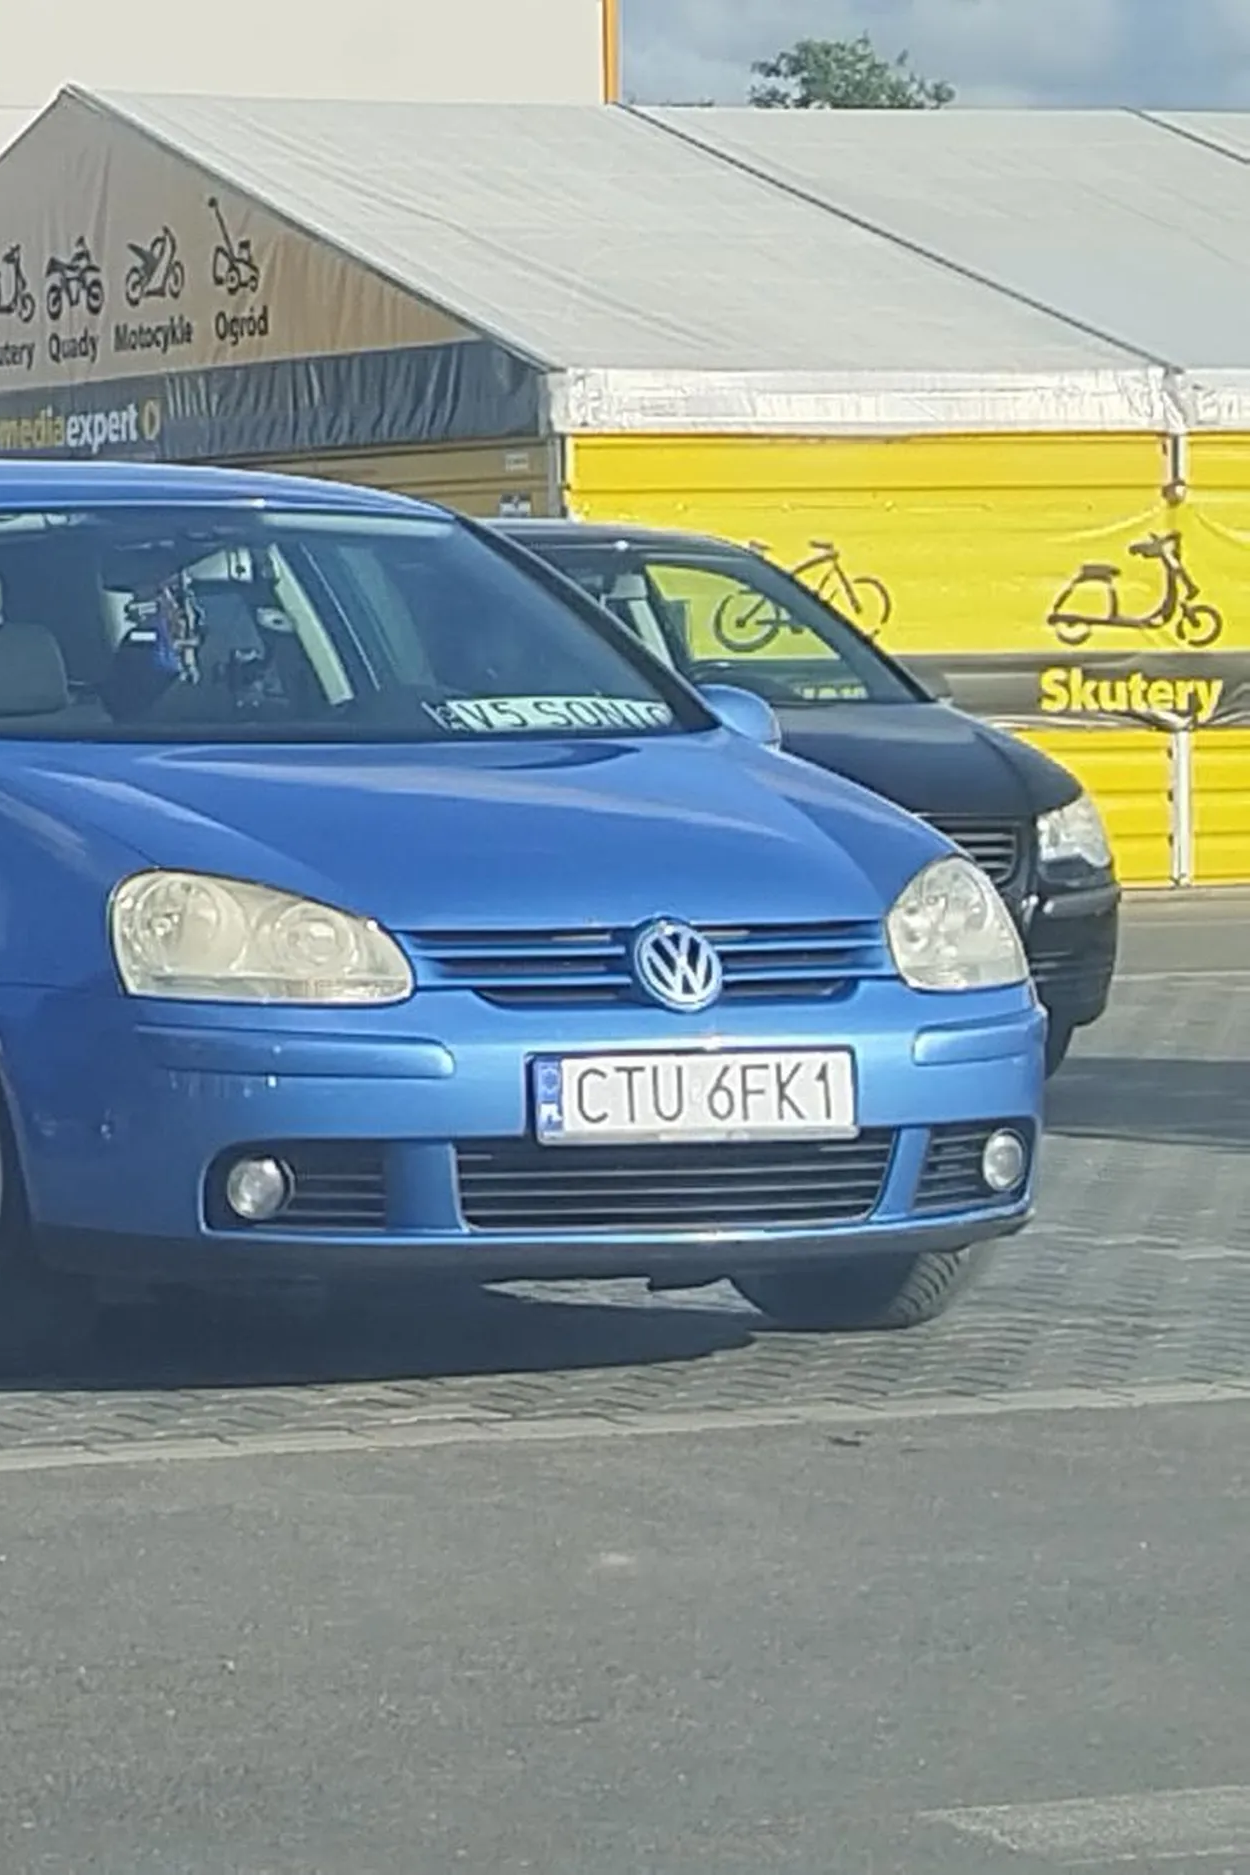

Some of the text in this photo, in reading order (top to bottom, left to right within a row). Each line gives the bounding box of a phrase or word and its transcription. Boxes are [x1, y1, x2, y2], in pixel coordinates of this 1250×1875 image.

[49, 332, 99, 363] Quady
[114, 315, 194, 354] Motocykle
[215, 305, 269, 344] Ogród
[1039, 668, 1224, 722] Skutery
[576, 1061, 834, 1124] CTU 6FK1
